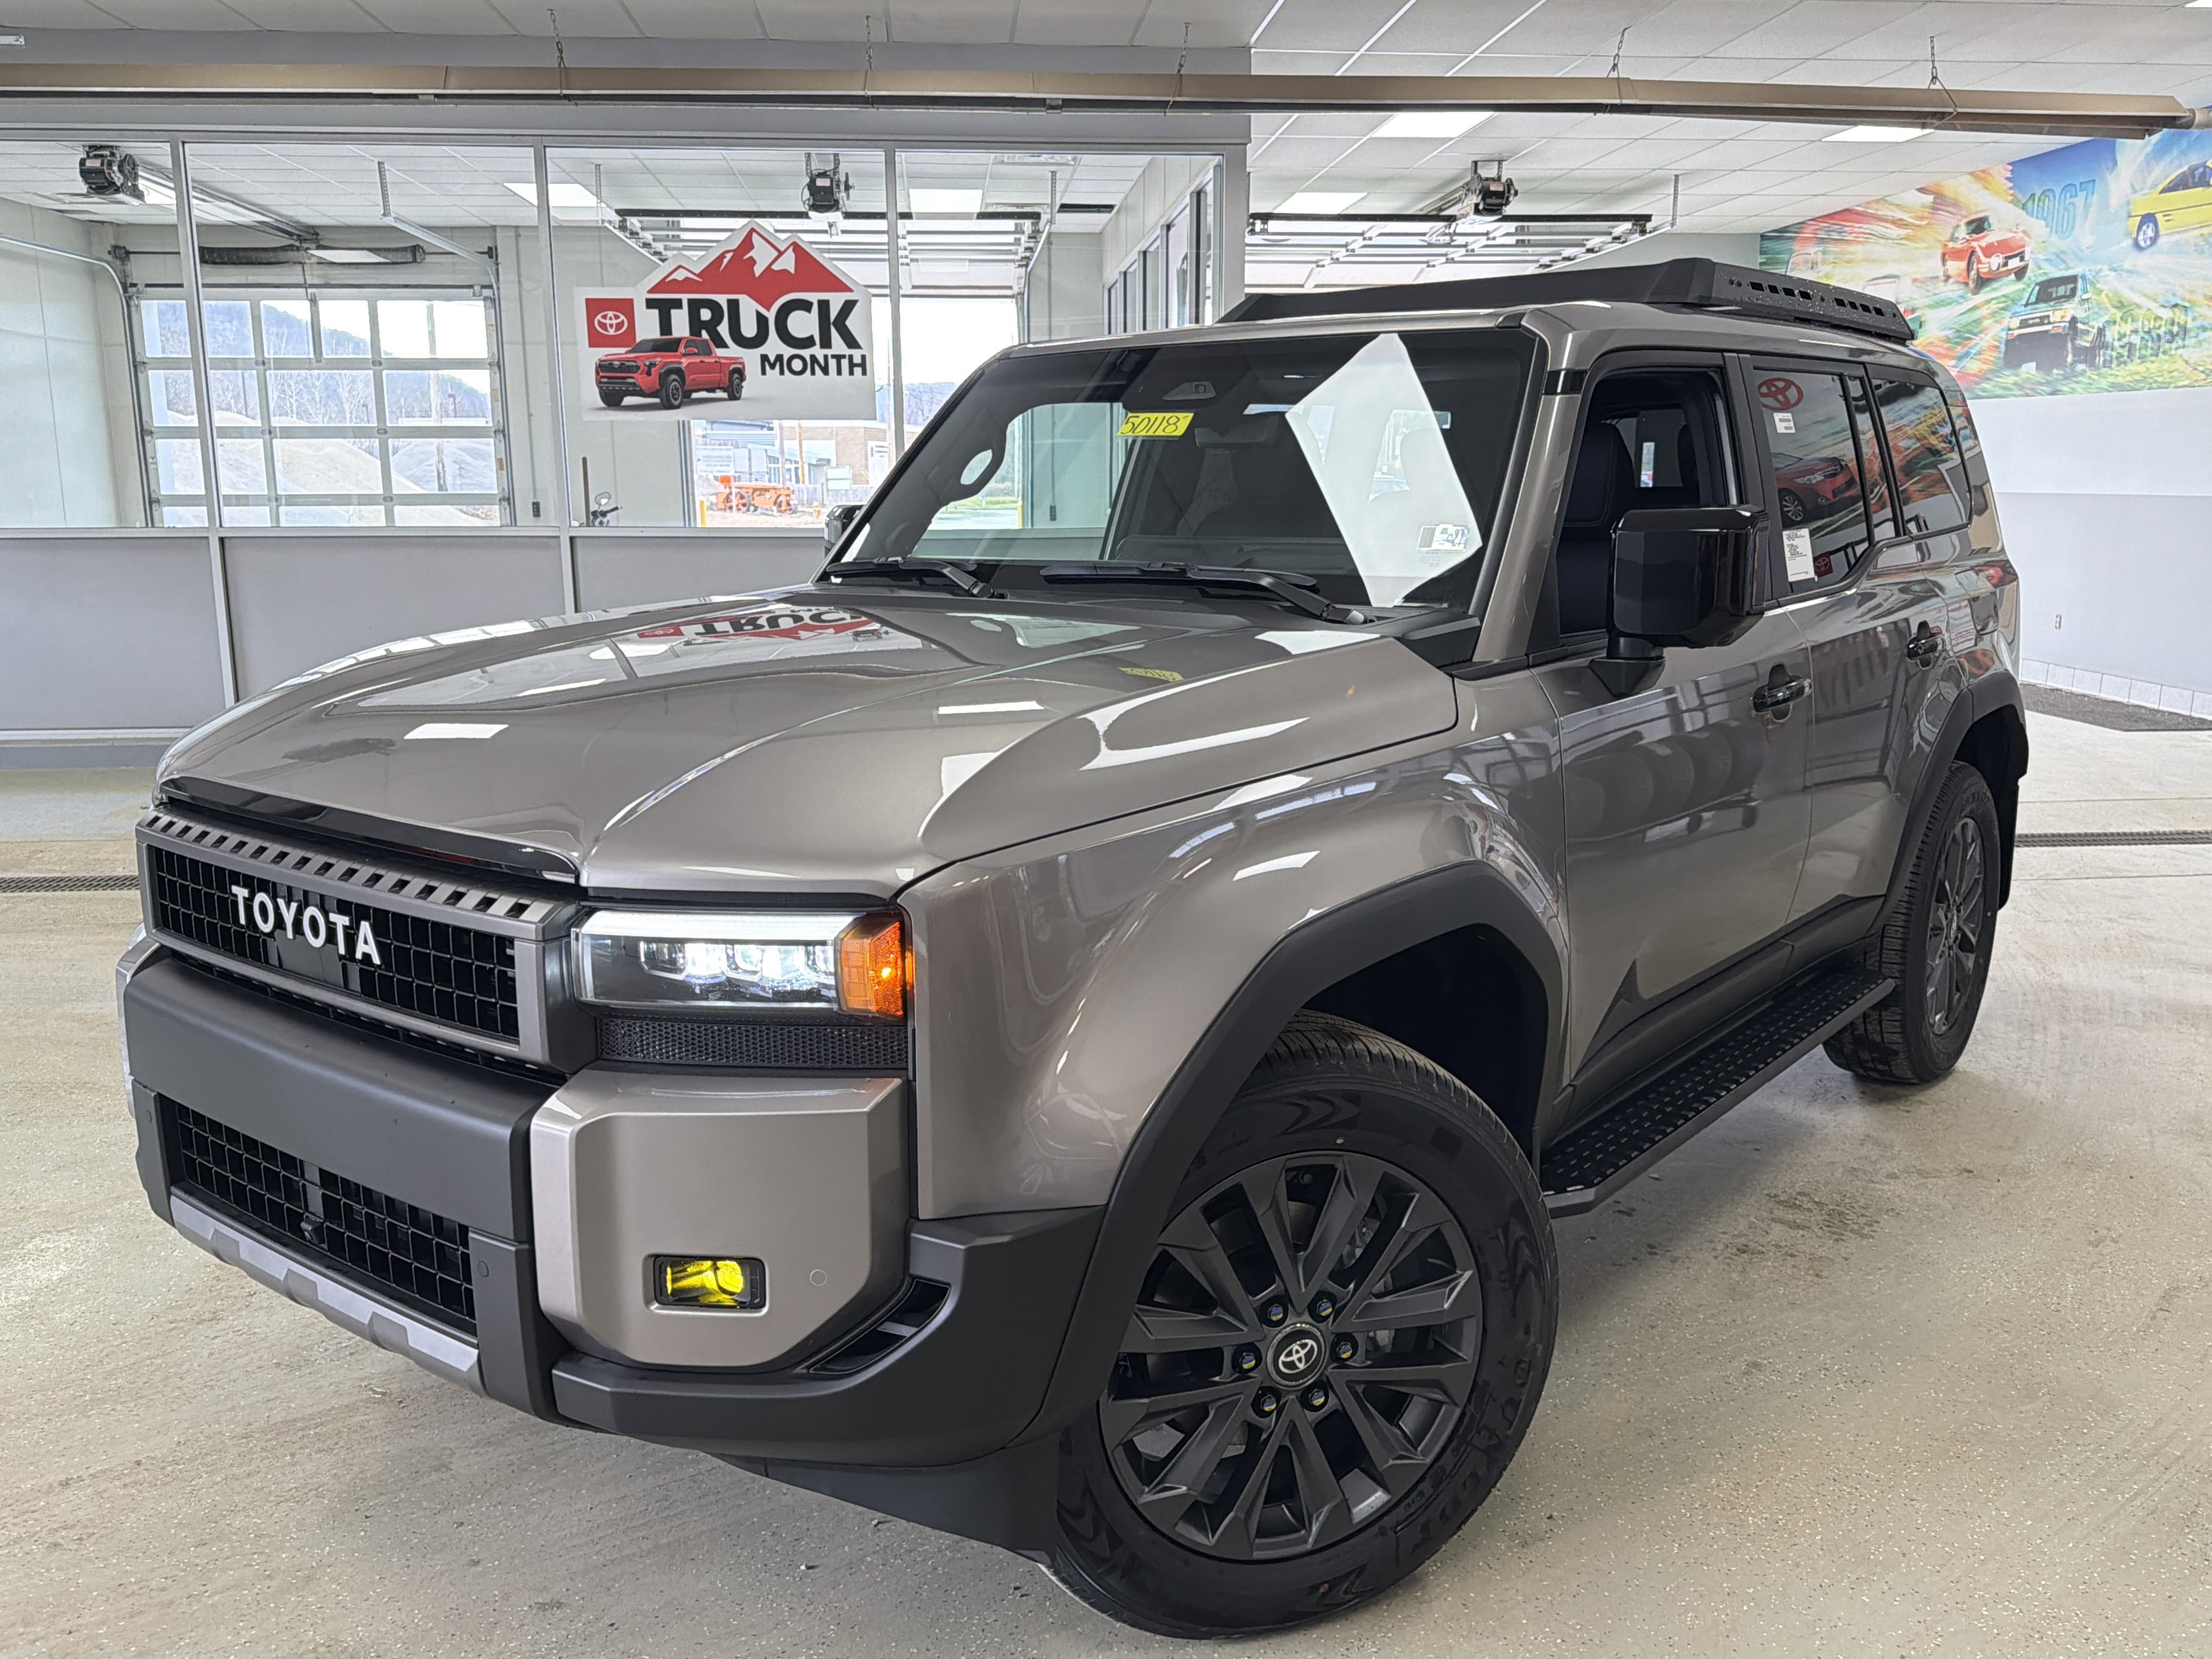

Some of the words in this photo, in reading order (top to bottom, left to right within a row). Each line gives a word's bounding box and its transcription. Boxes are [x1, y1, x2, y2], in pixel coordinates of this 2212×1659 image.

[645, 298, 863, 349] TRUCK
[761, 353, 867, 377] MONTH
[1120, 415, 1181, 435] 50118
[231, 884, 381, 965] TOYOTA
